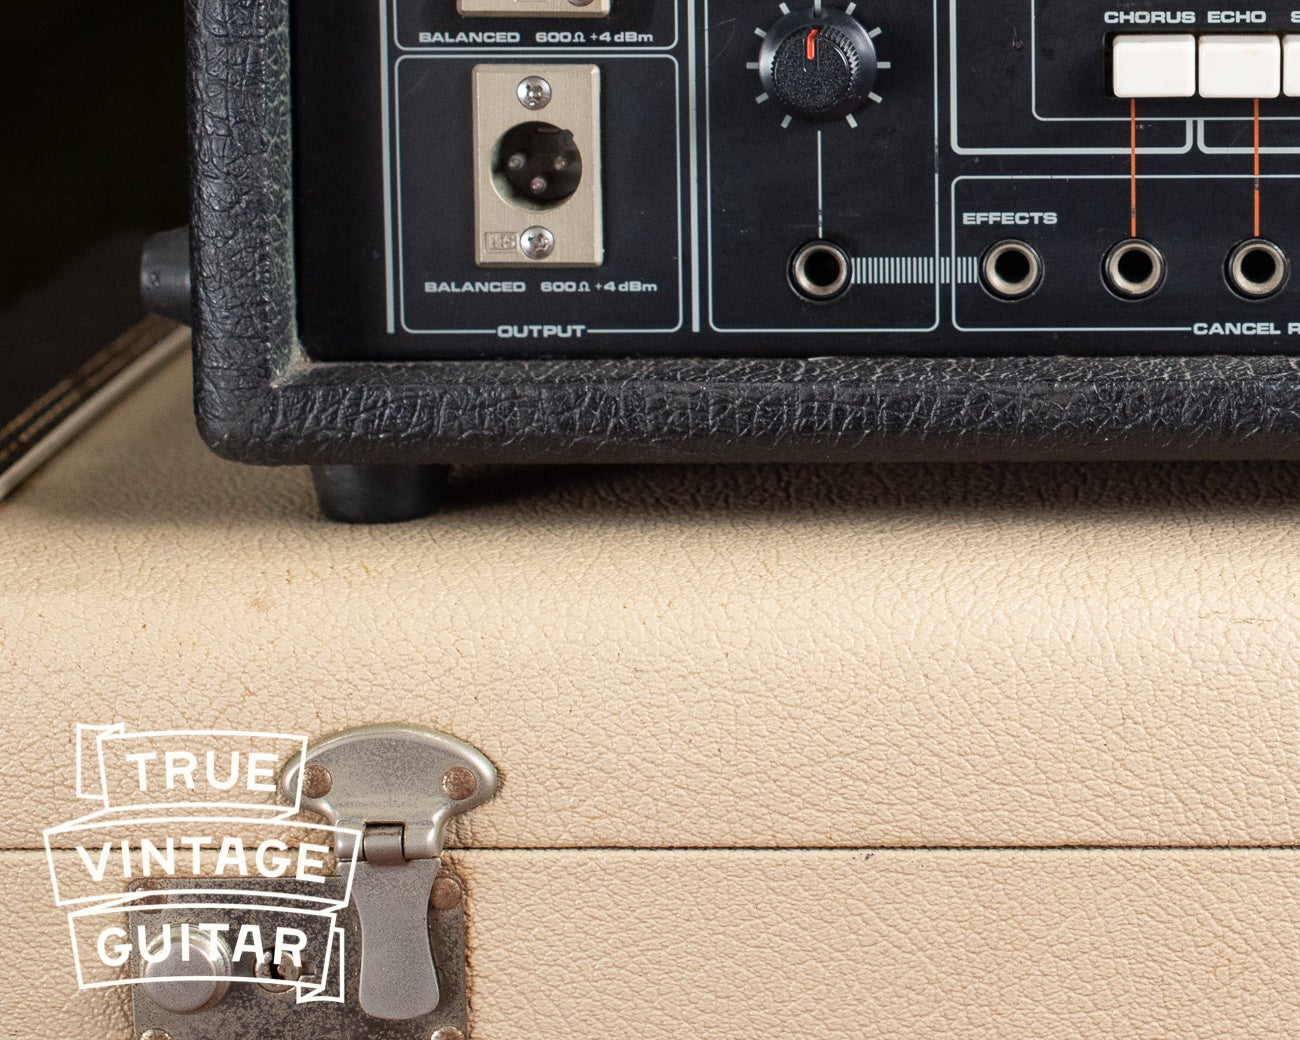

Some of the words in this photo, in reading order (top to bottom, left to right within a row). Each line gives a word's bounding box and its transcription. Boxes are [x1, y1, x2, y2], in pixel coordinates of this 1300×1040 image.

[1103, 10, 1196, 24] CHORUS
[1207, 10, 1267, 24] ECHO
[418, 31, 521, 43] BALANCED
[962, 211, 1058, 225] EFFECTS
[424, 281, 527, 293] BALANCED
[497, 325, 587, 338] OUTPUT
[1193, 322, 1282, 335] CANCEL
